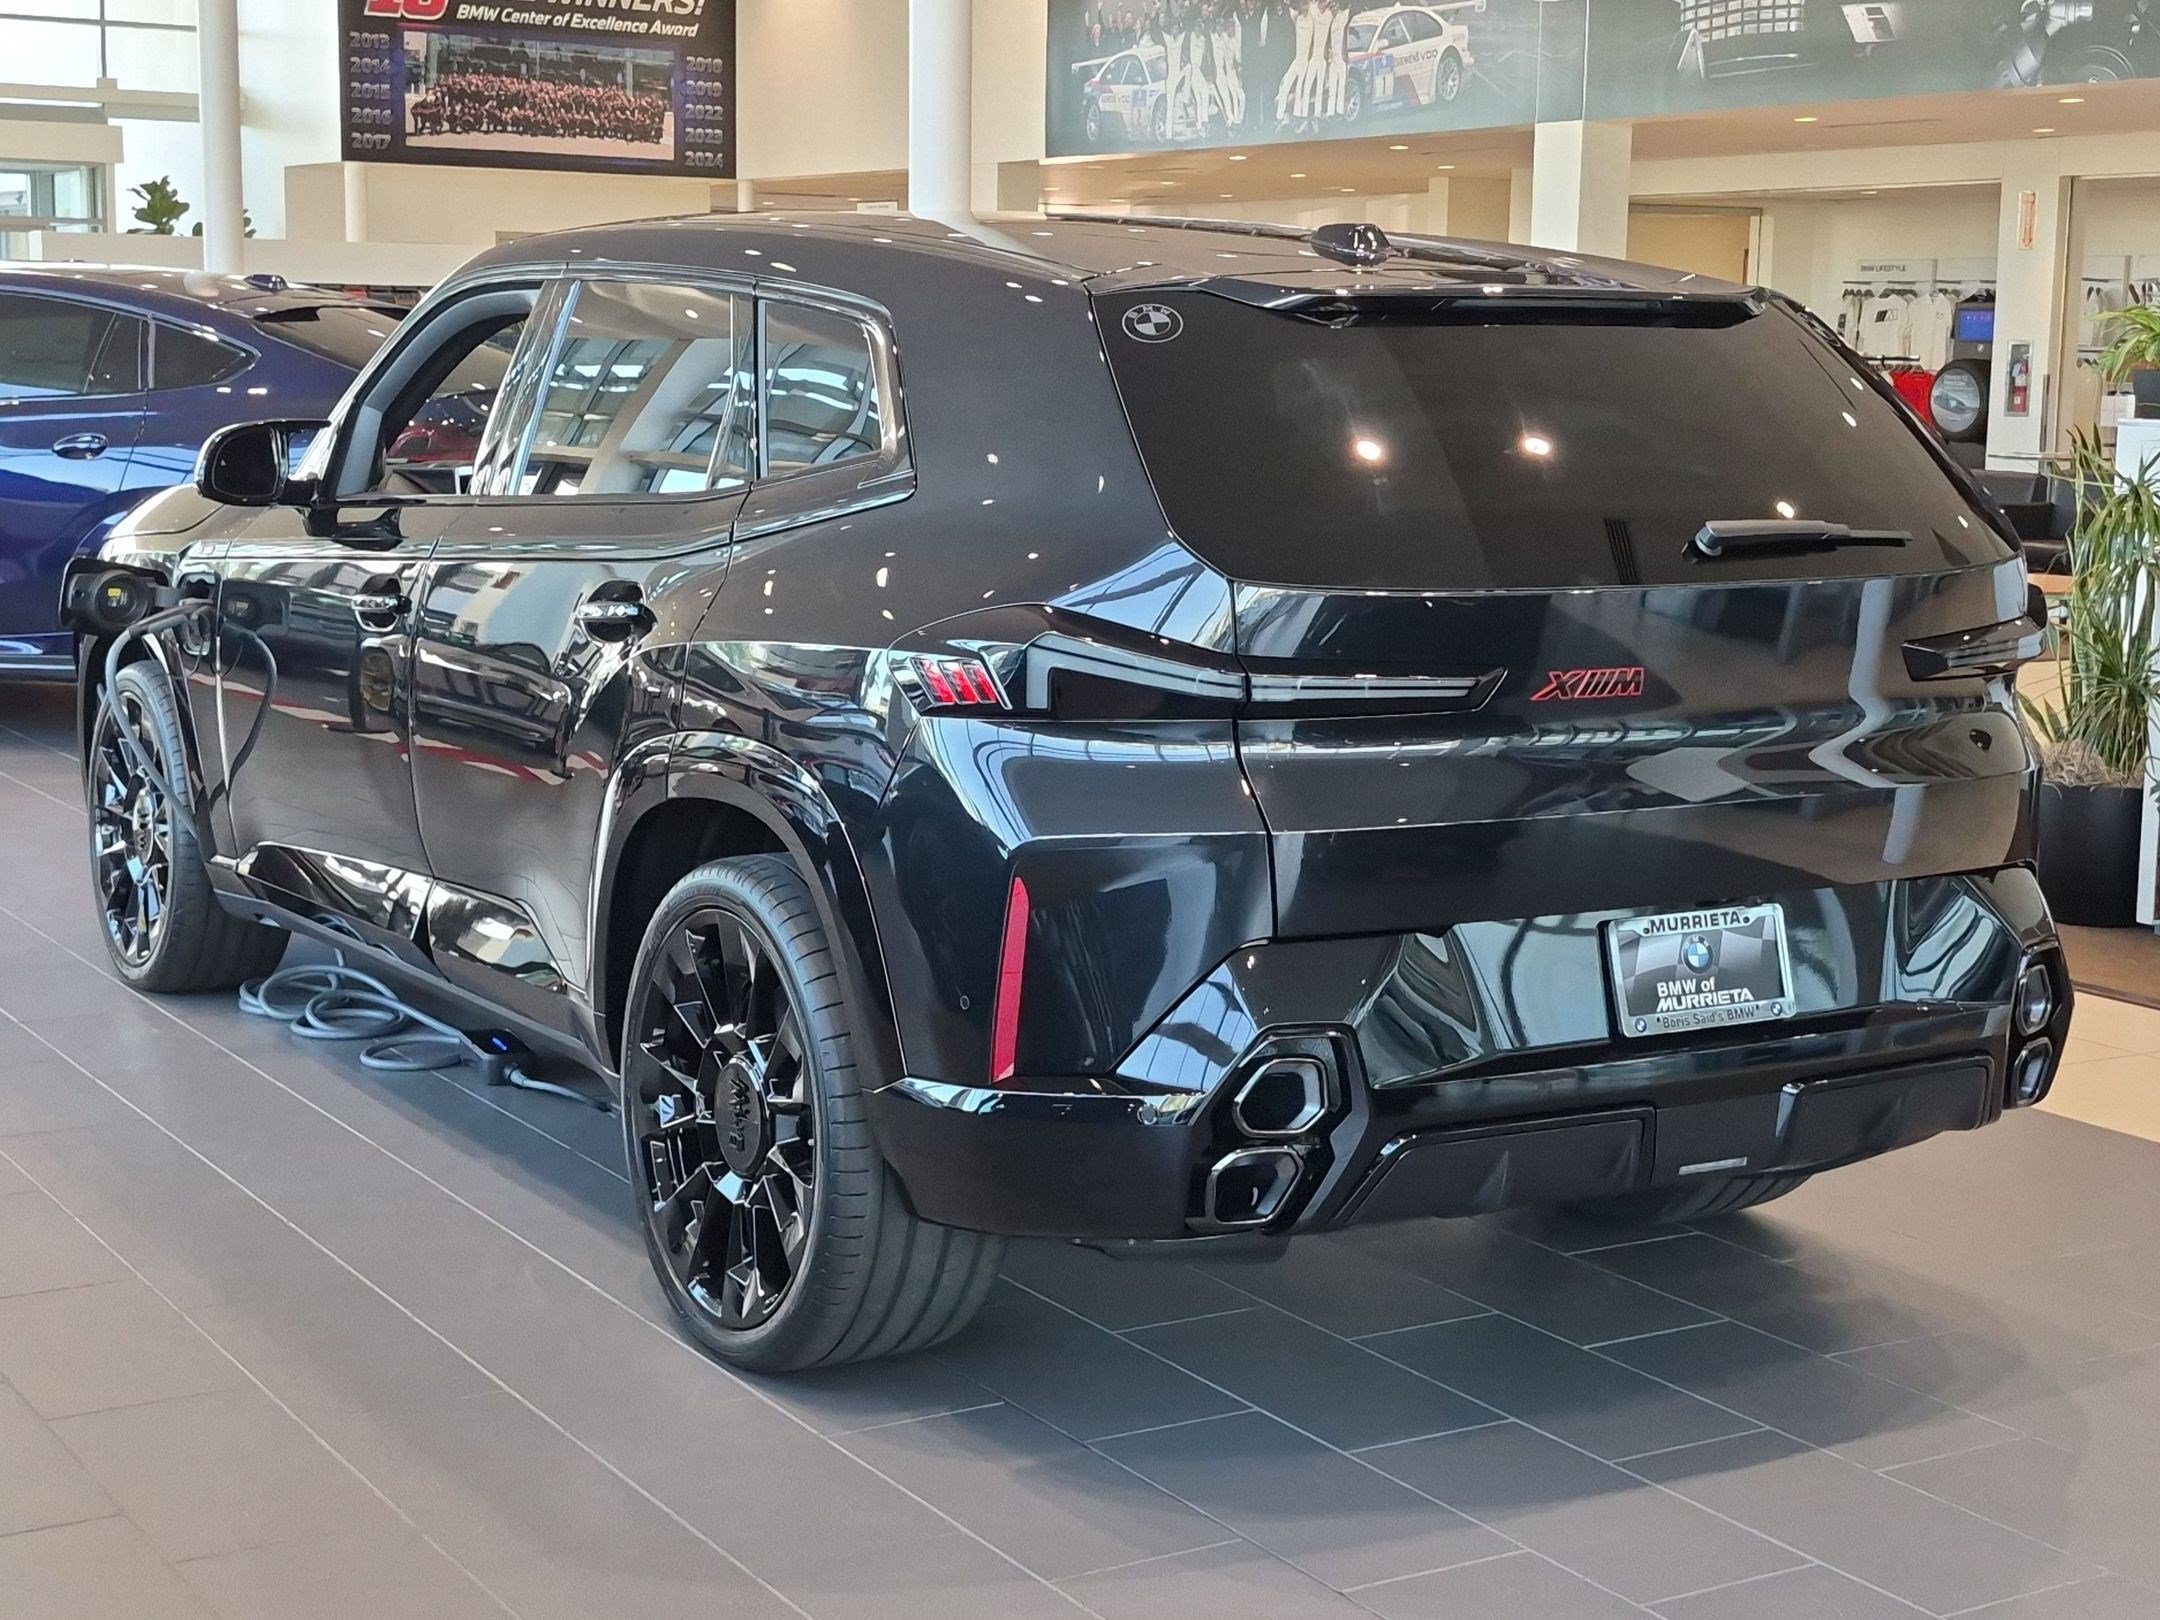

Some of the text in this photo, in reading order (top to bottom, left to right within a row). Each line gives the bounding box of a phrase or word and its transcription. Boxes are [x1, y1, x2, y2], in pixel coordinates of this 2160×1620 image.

[456, 4, 500, 21] BMW
[501, 8, 552, 25] Center
[552, 13, 571, 27] of
[570, 13, 648, 34] Excellence
[649, 19, 699, 37] Award
[349, 31, 390, 49] 2013
[1420, 48, 1438, 60] VDO
[350, 57, 390, 74] 2014
[686, 56, 723, 73] 2018
[351, 82, 391, 99] 2015
[686, 80, 722, 97] 2019
[351, 107, 392, 125] 2016
[685, 103, 723, 120] 2022
[351, 132, 391, 149] 2017
[685, 127, 723, 144] 2023
[684, 150, 723, 168] 2024
[1875, 264, 1905, 272] LIFESTYLE
[1128, 305, 1171, 319] BMW
[1650, 910, 1742, 934] MURRIETA
[1656, 976, 1715, 997] BMW of
[1656, 987, 1755, 1013] MURRIETA
[1693, 1010, 1724, 1025] Said's
